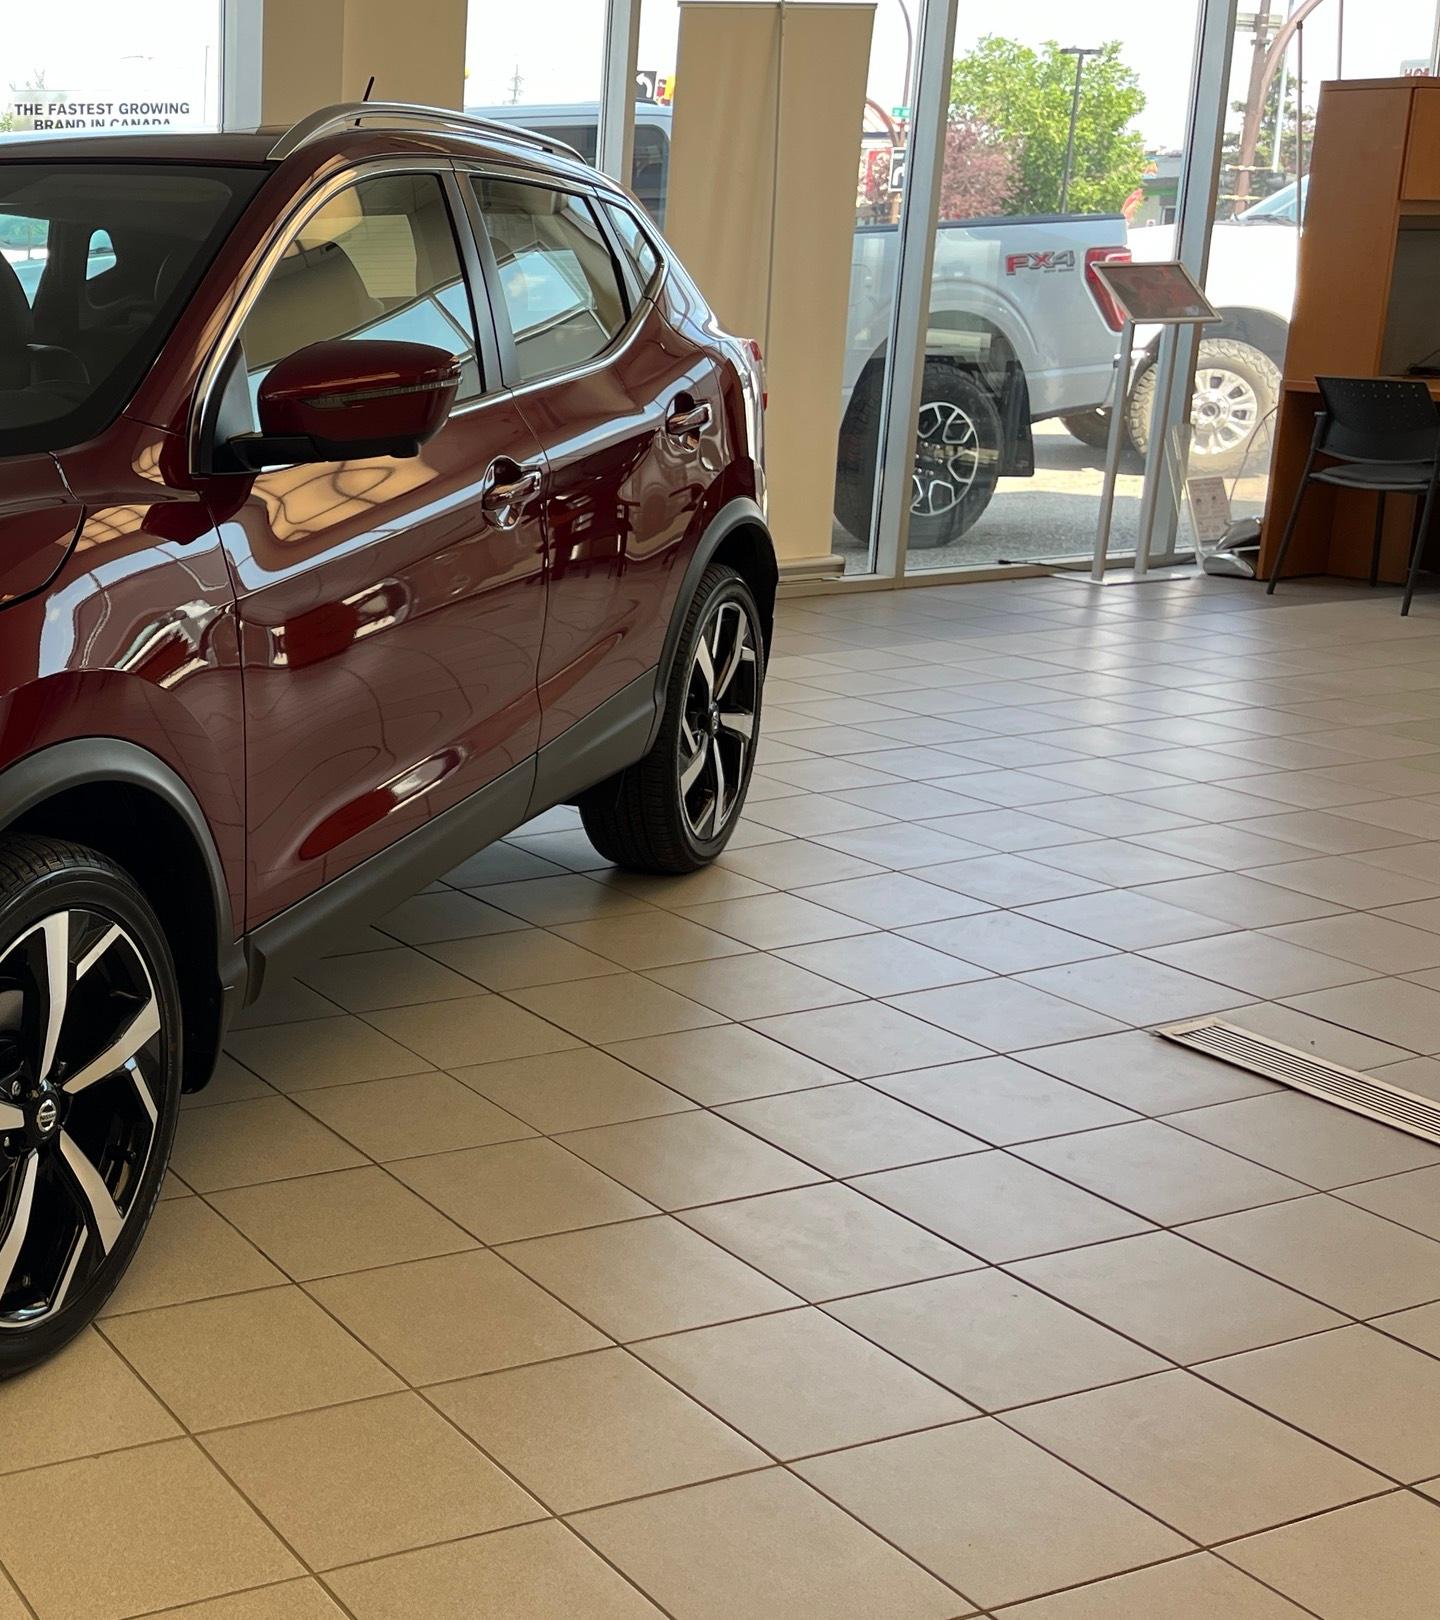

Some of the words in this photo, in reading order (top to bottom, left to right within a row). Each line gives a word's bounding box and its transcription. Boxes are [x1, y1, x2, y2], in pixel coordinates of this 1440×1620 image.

[14, 103, 43, 115] THE
[48, 103, 113, 115] FASTEST
[119, 102, 190, 115] GROWING
[34, 119, 86, 130] BRAND
[91, 118, 105, 128] IN
[1005, 250, 1075, 276] FX4
